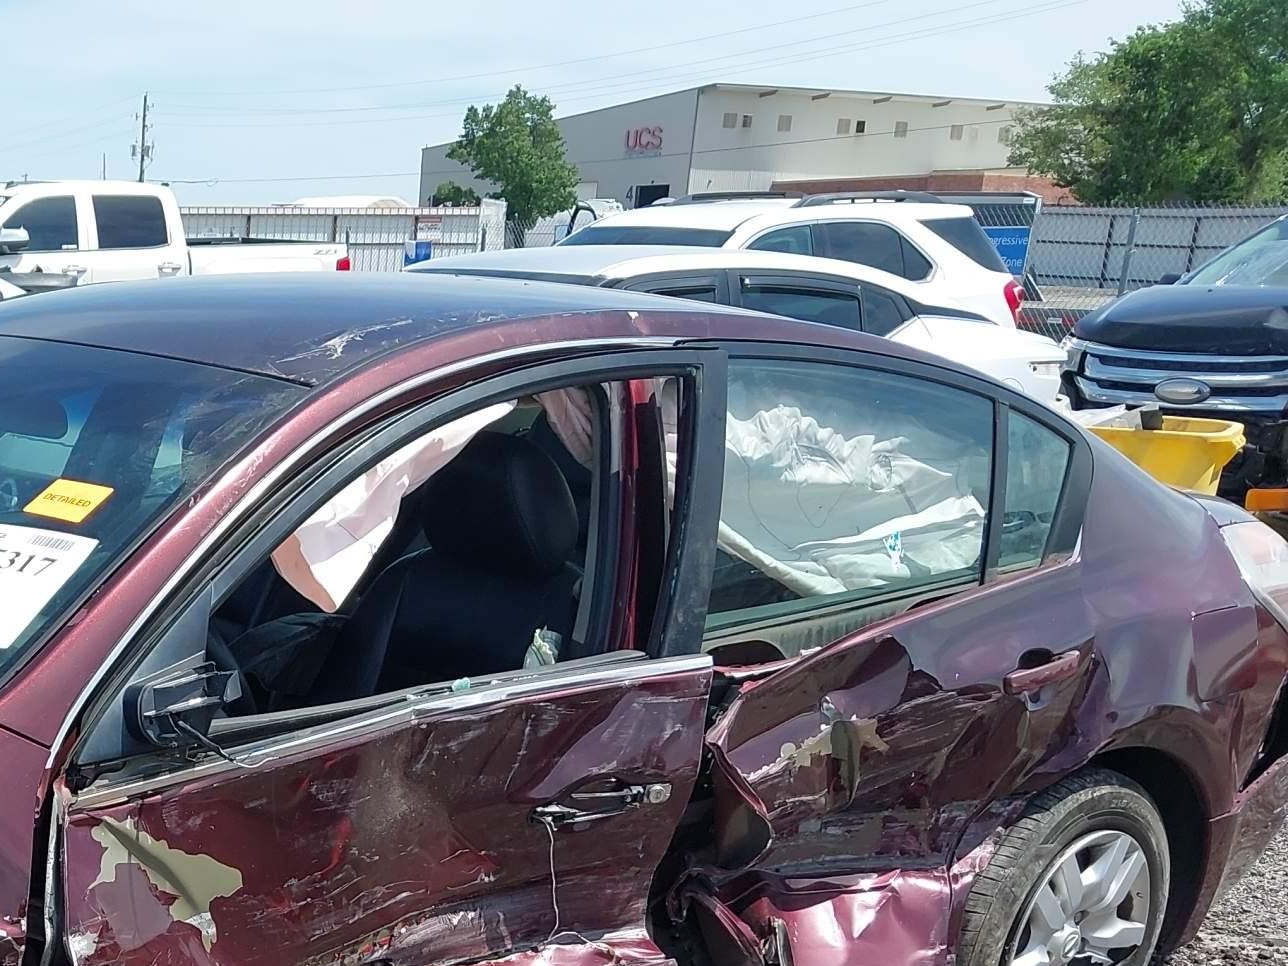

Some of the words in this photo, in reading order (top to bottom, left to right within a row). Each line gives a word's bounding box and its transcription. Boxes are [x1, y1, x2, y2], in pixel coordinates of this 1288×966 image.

[624, 126, 664, 150] UCS
[626, 186, 633, 202] 4
[990, 235, 1029, 248] gressive
[42, 492, 92, 507] DETAILED
